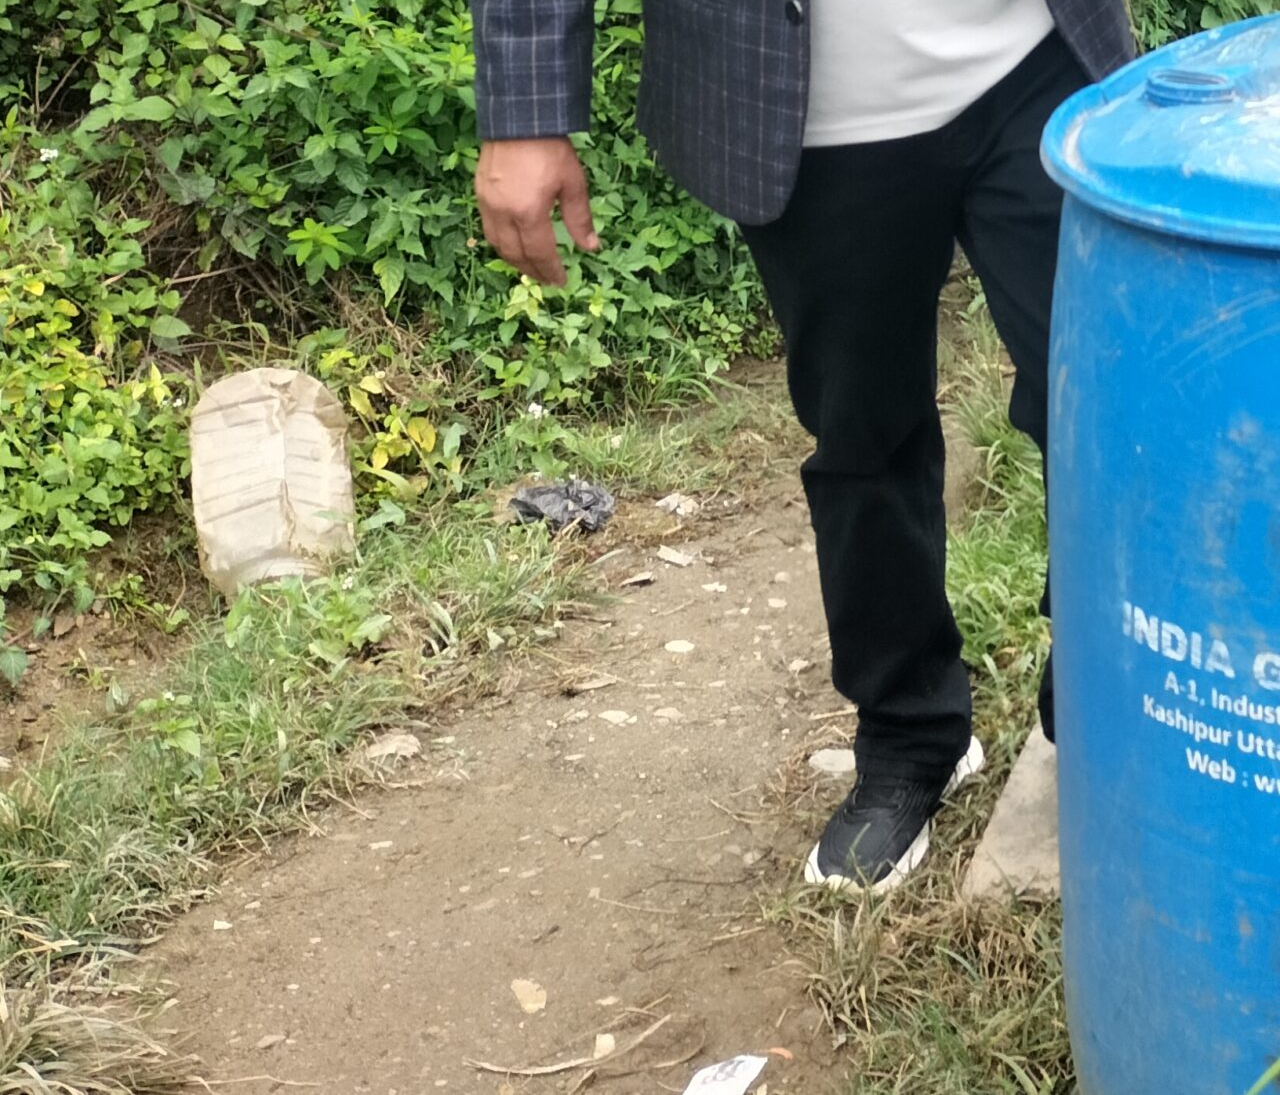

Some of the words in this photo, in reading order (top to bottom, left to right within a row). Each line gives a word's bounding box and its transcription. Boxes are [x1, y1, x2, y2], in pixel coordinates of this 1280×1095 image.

[1122, 601, 1236, 679] INDIA
[1142, 693, 1232, 747] Kashipur
[1185, 747, 1237, 784] Web
